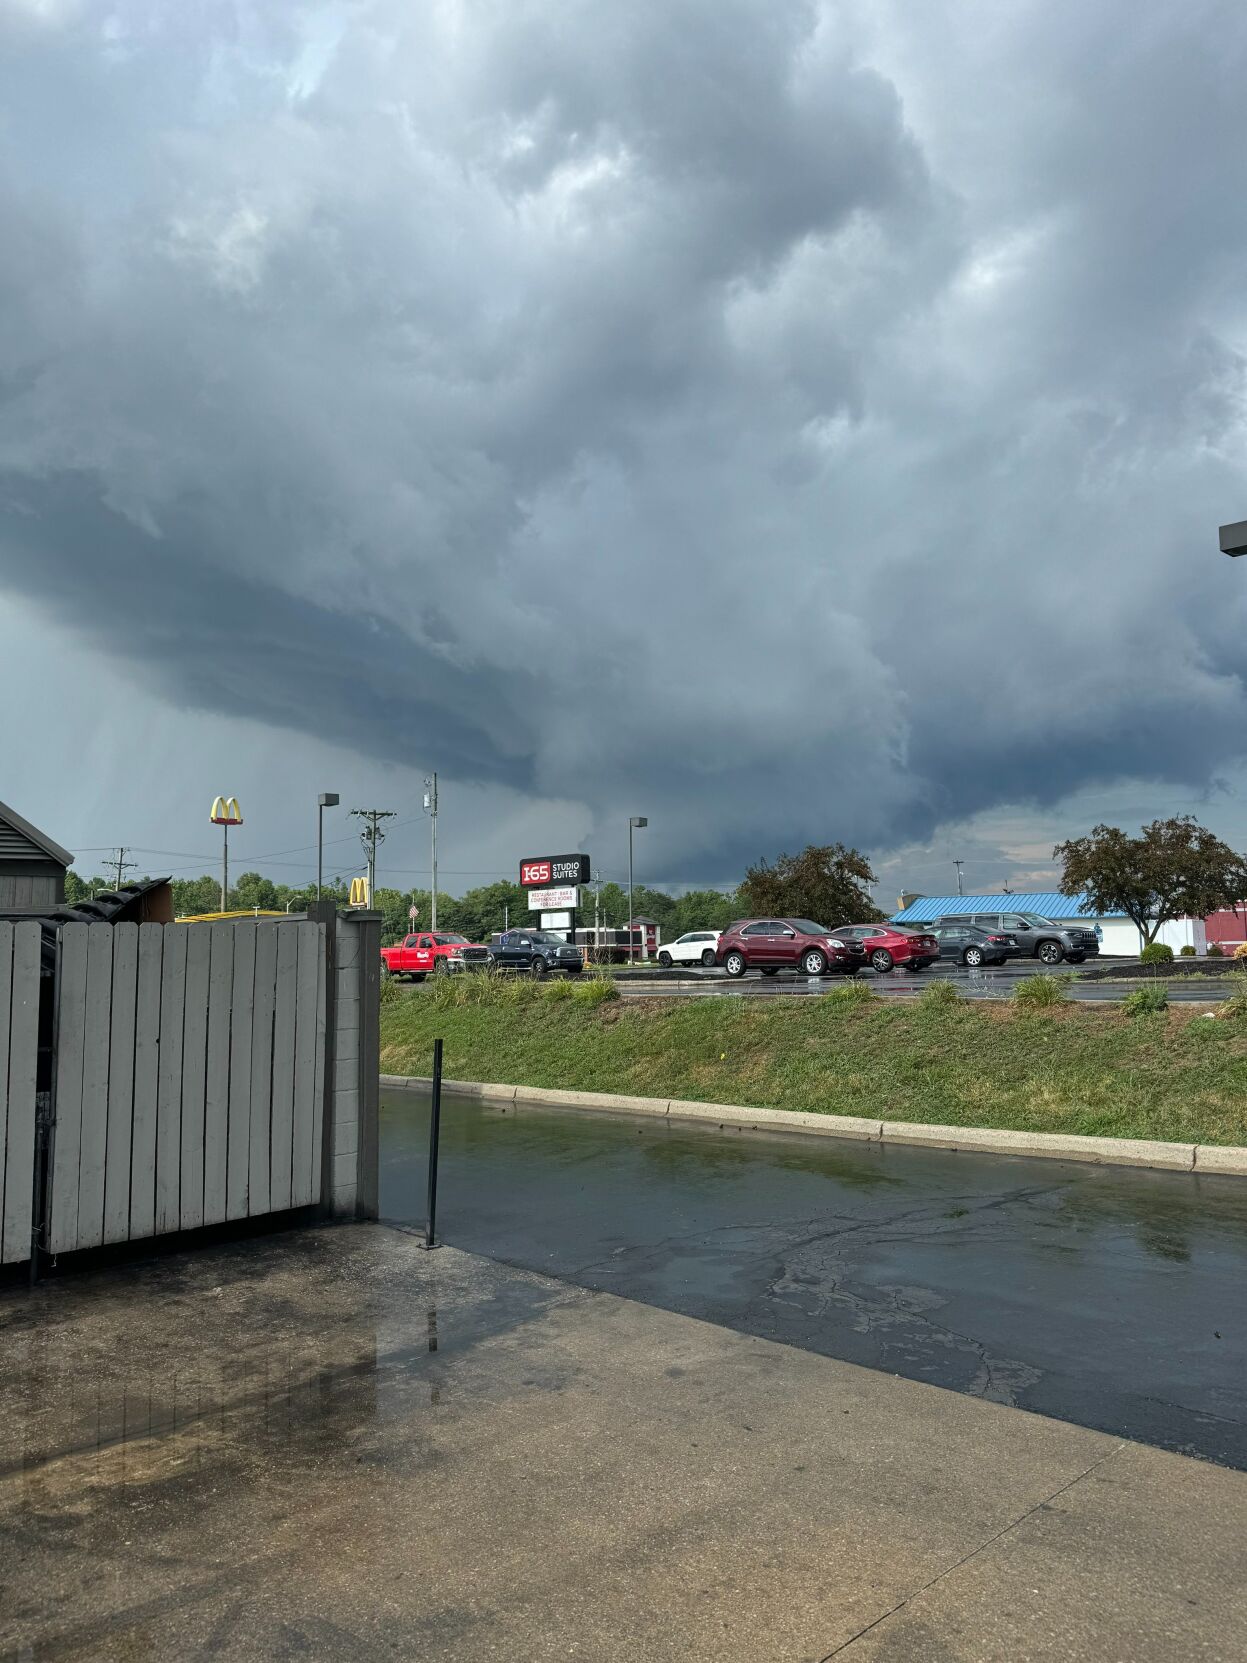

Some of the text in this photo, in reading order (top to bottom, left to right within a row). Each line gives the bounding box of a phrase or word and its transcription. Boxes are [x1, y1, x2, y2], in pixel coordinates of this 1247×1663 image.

[552, 862, 580, 872] STUDIO
[524, 866, 548, 881] I-65
[552, 870, 578, 879] SUITES
